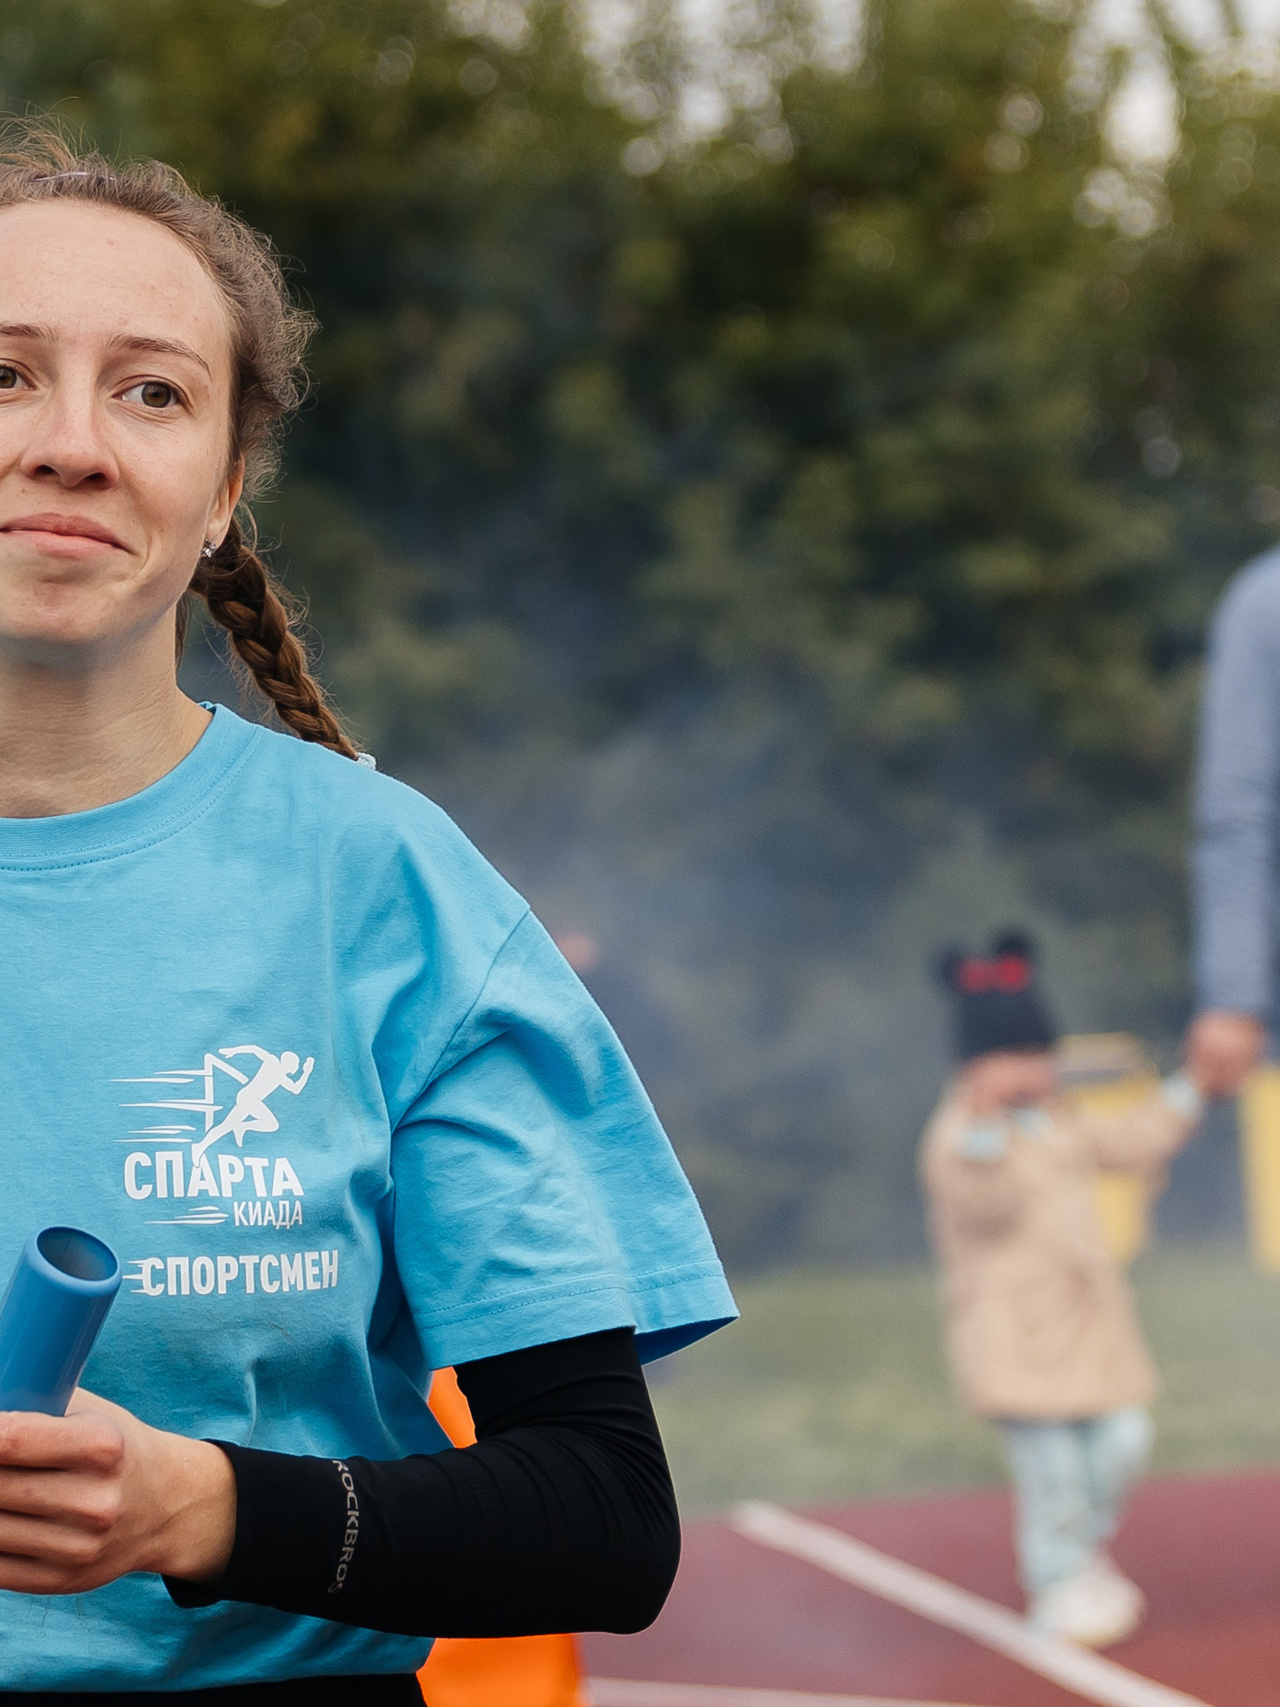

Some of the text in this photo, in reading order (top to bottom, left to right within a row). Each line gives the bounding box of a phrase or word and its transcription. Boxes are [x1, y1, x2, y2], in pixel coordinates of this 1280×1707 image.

[123, 1150, 305, 1200] СПАРТА
[232, 1200, 304, 1229] КИАДА
[138, 1249, 340, 1297] СПОРТСМЕН
[327, 1459, 360, 1595] ROCKBROS
